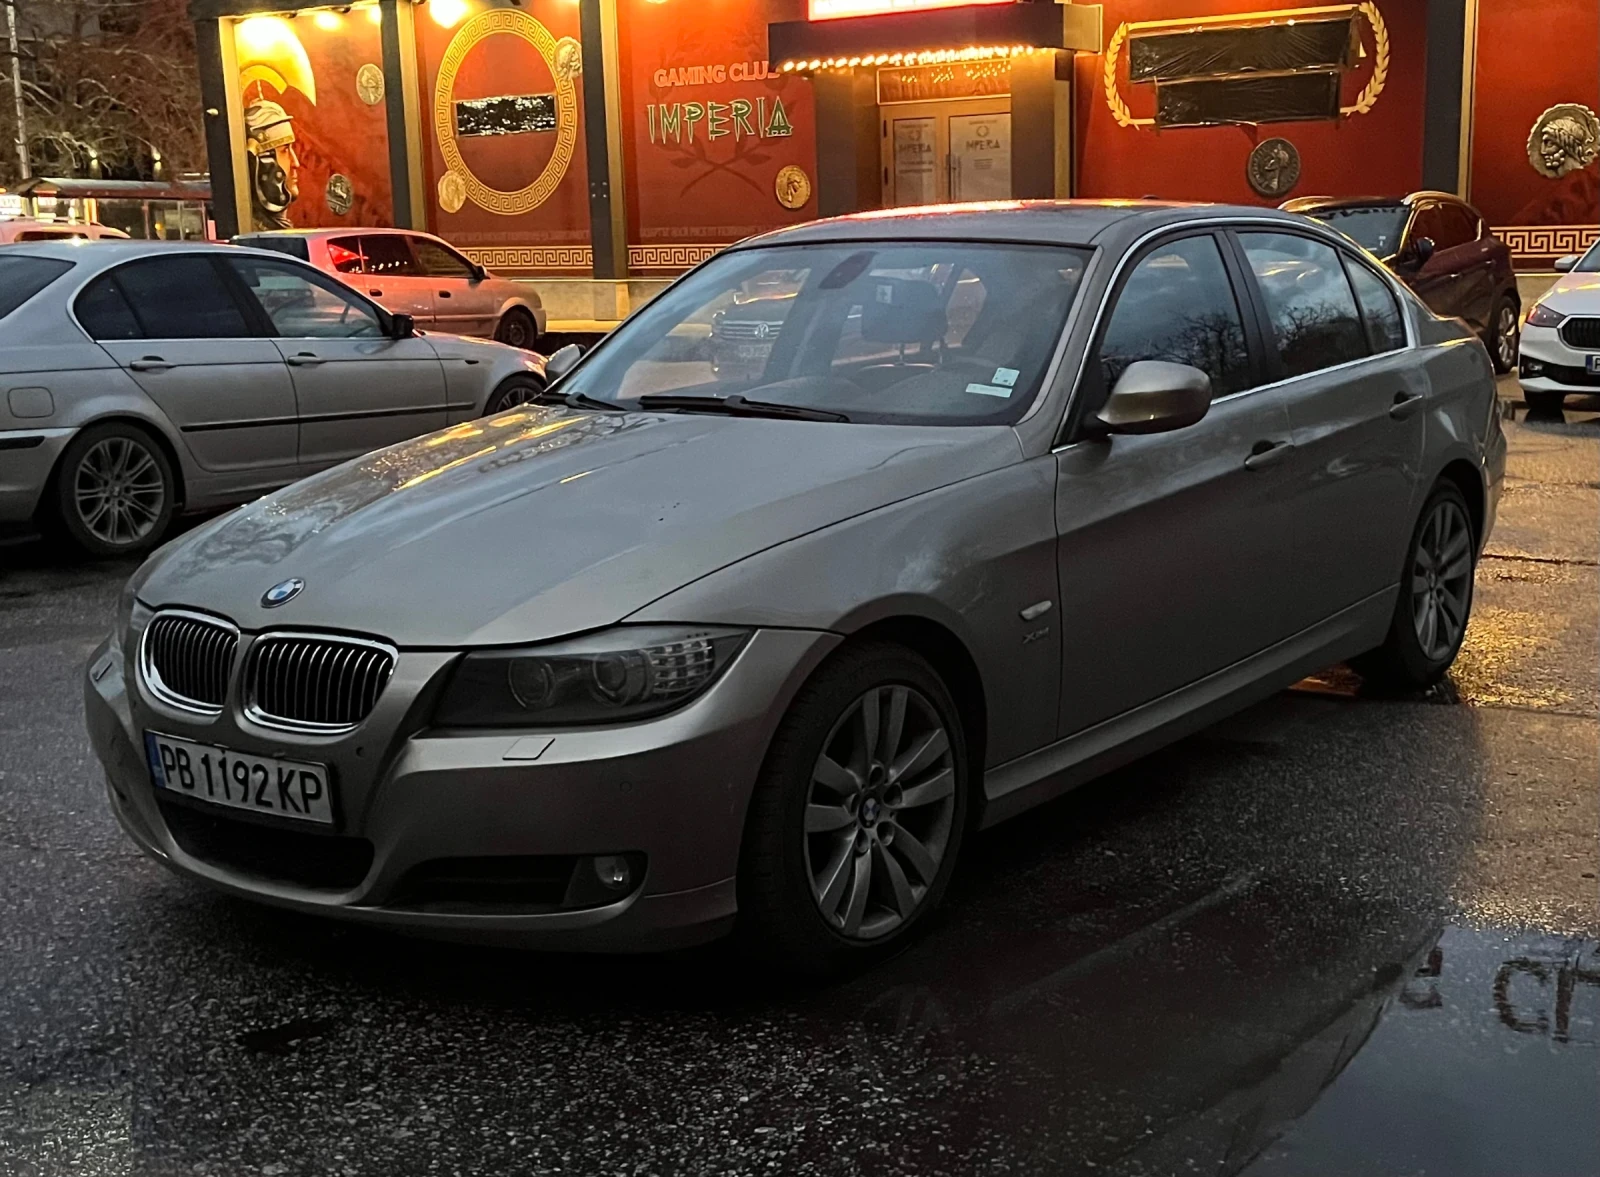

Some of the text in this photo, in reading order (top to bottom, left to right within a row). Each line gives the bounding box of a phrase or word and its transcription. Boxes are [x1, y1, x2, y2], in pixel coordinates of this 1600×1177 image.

[653, 61, 781, 88] GAMING CLU
[646, 96, 794, 144] IMPERIA
